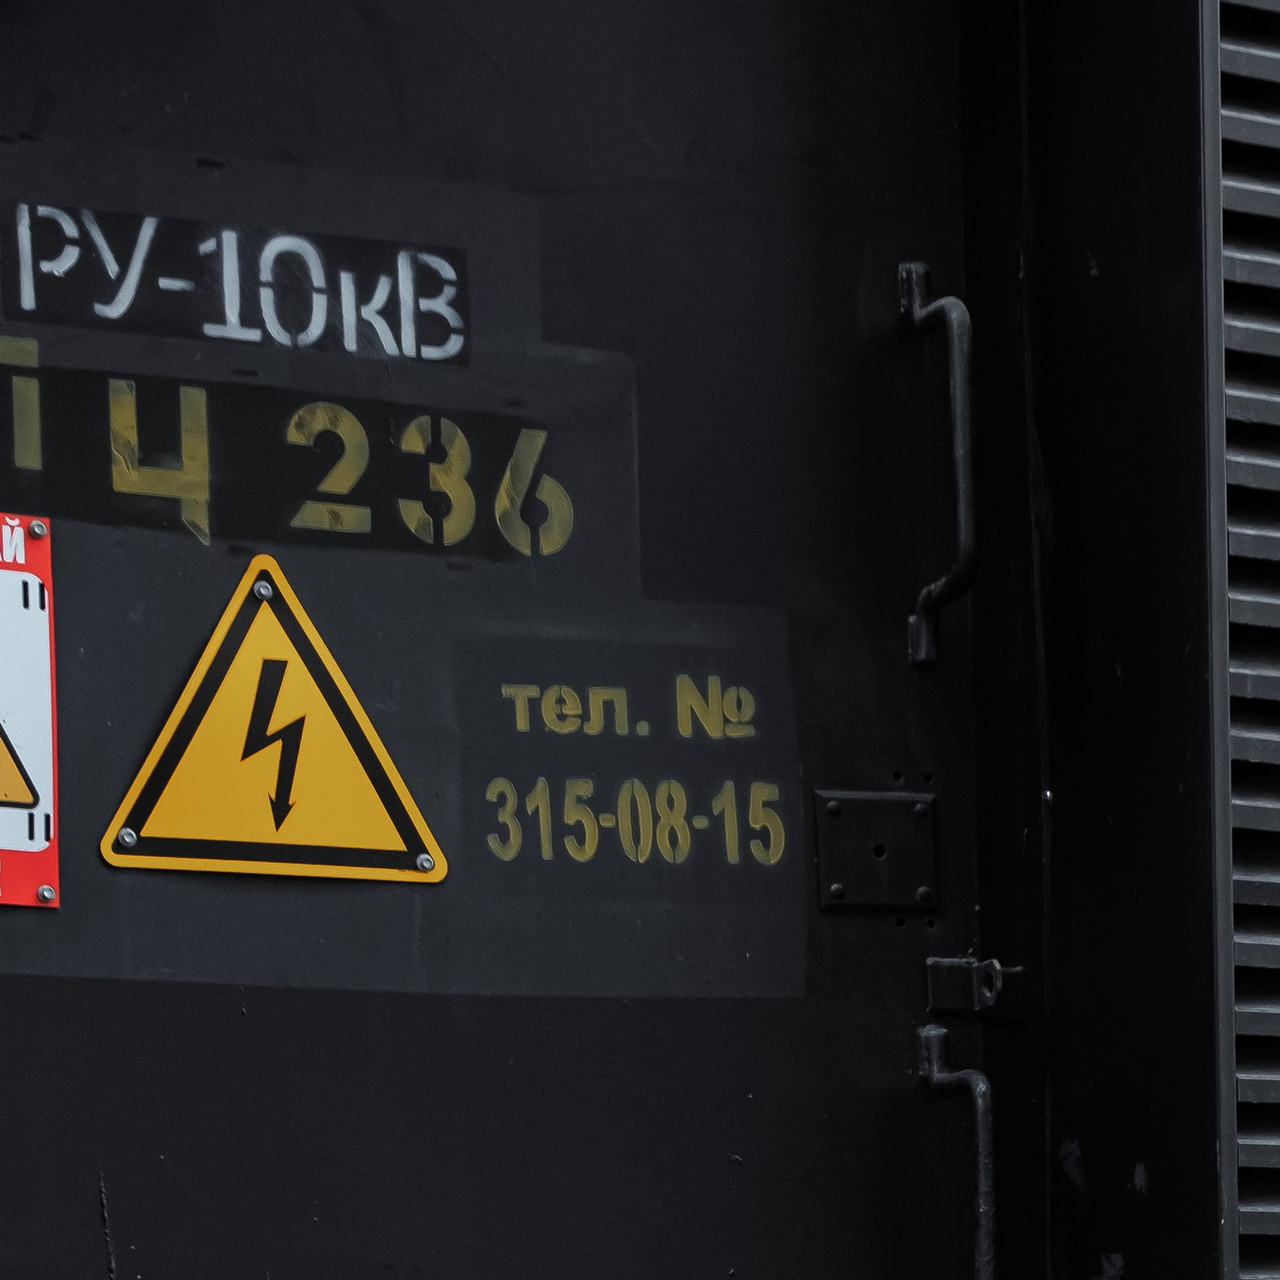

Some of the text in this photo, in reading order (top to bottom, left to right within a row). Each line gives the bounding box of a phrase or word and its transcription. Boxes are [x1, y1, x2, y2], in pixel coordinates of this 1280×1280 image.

[16, 203, 465, 362] РУ-10кВ
[286, 400, 575, 557] 236
[501, 673, 756, 739] тел. №
[484, 775, 786, 866] 315-08-15
